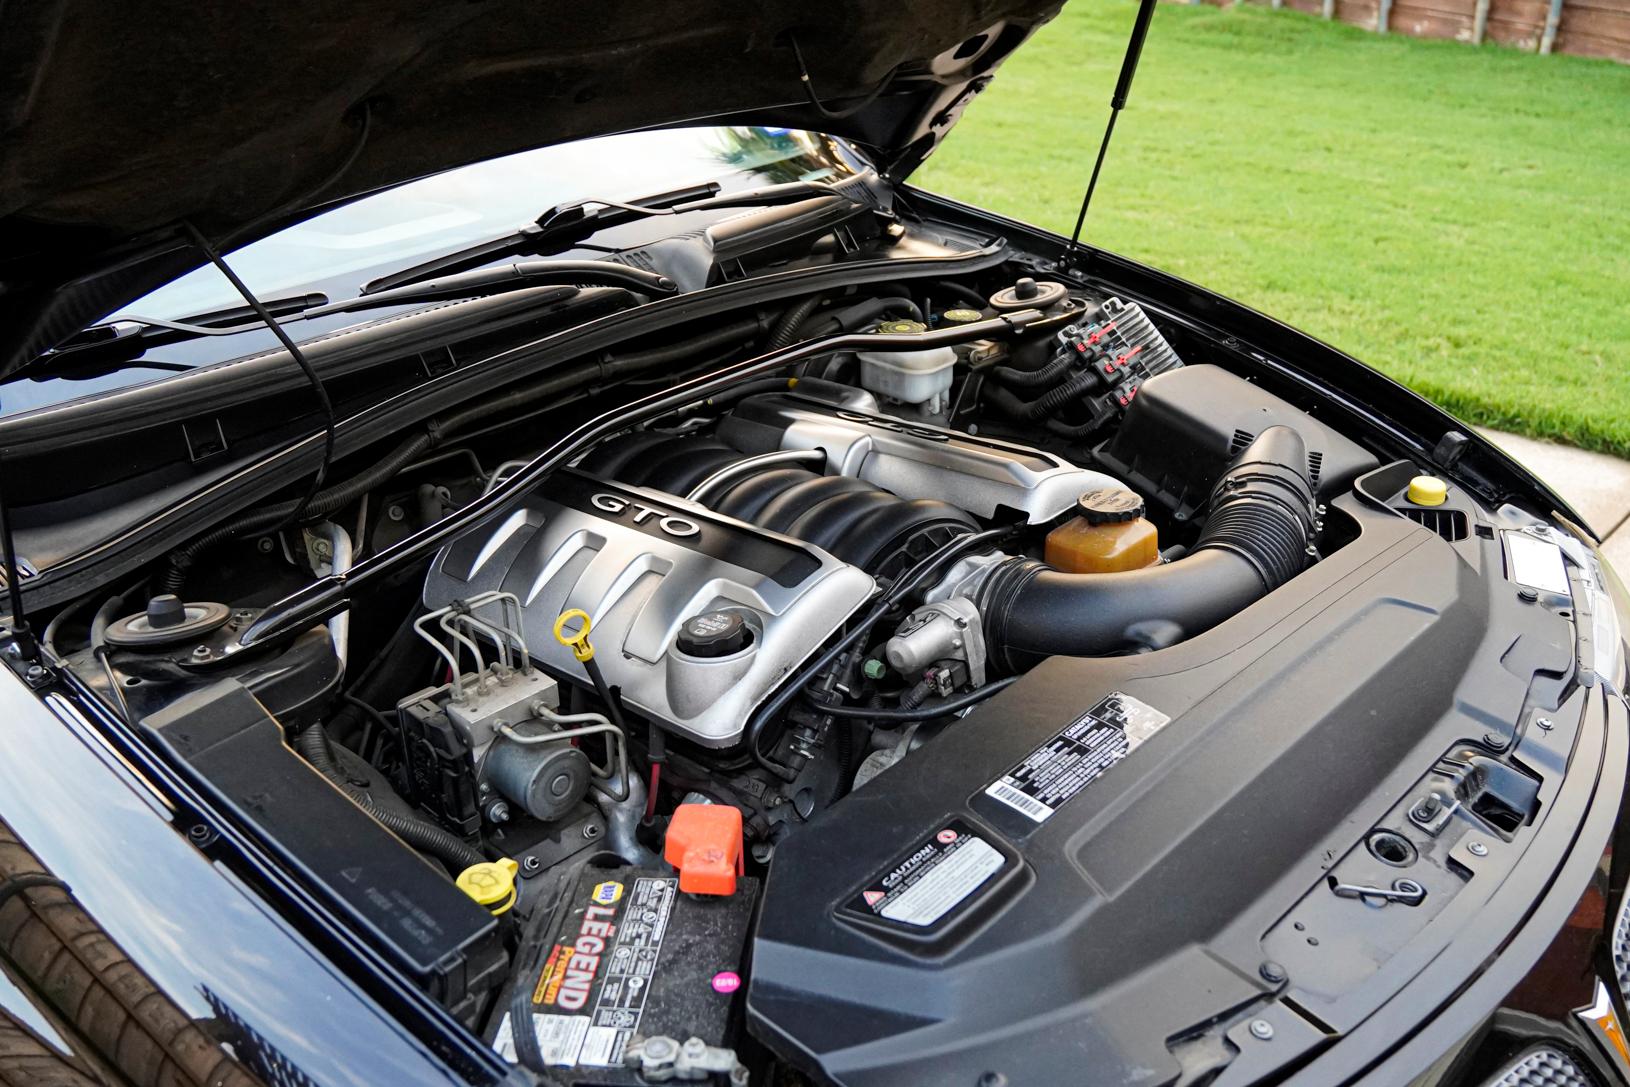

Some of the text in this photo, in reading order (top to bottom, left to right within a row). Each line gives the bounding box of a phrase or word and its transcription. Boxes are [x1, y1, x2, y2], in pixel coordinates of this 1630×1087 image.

[591, 493, 701, 538] GTO
[1064, 715, 1093, 737] CATALYST
[881, 843, 936, 887] CAUTION!
[557, 905, 617, 1010] LEGEND
